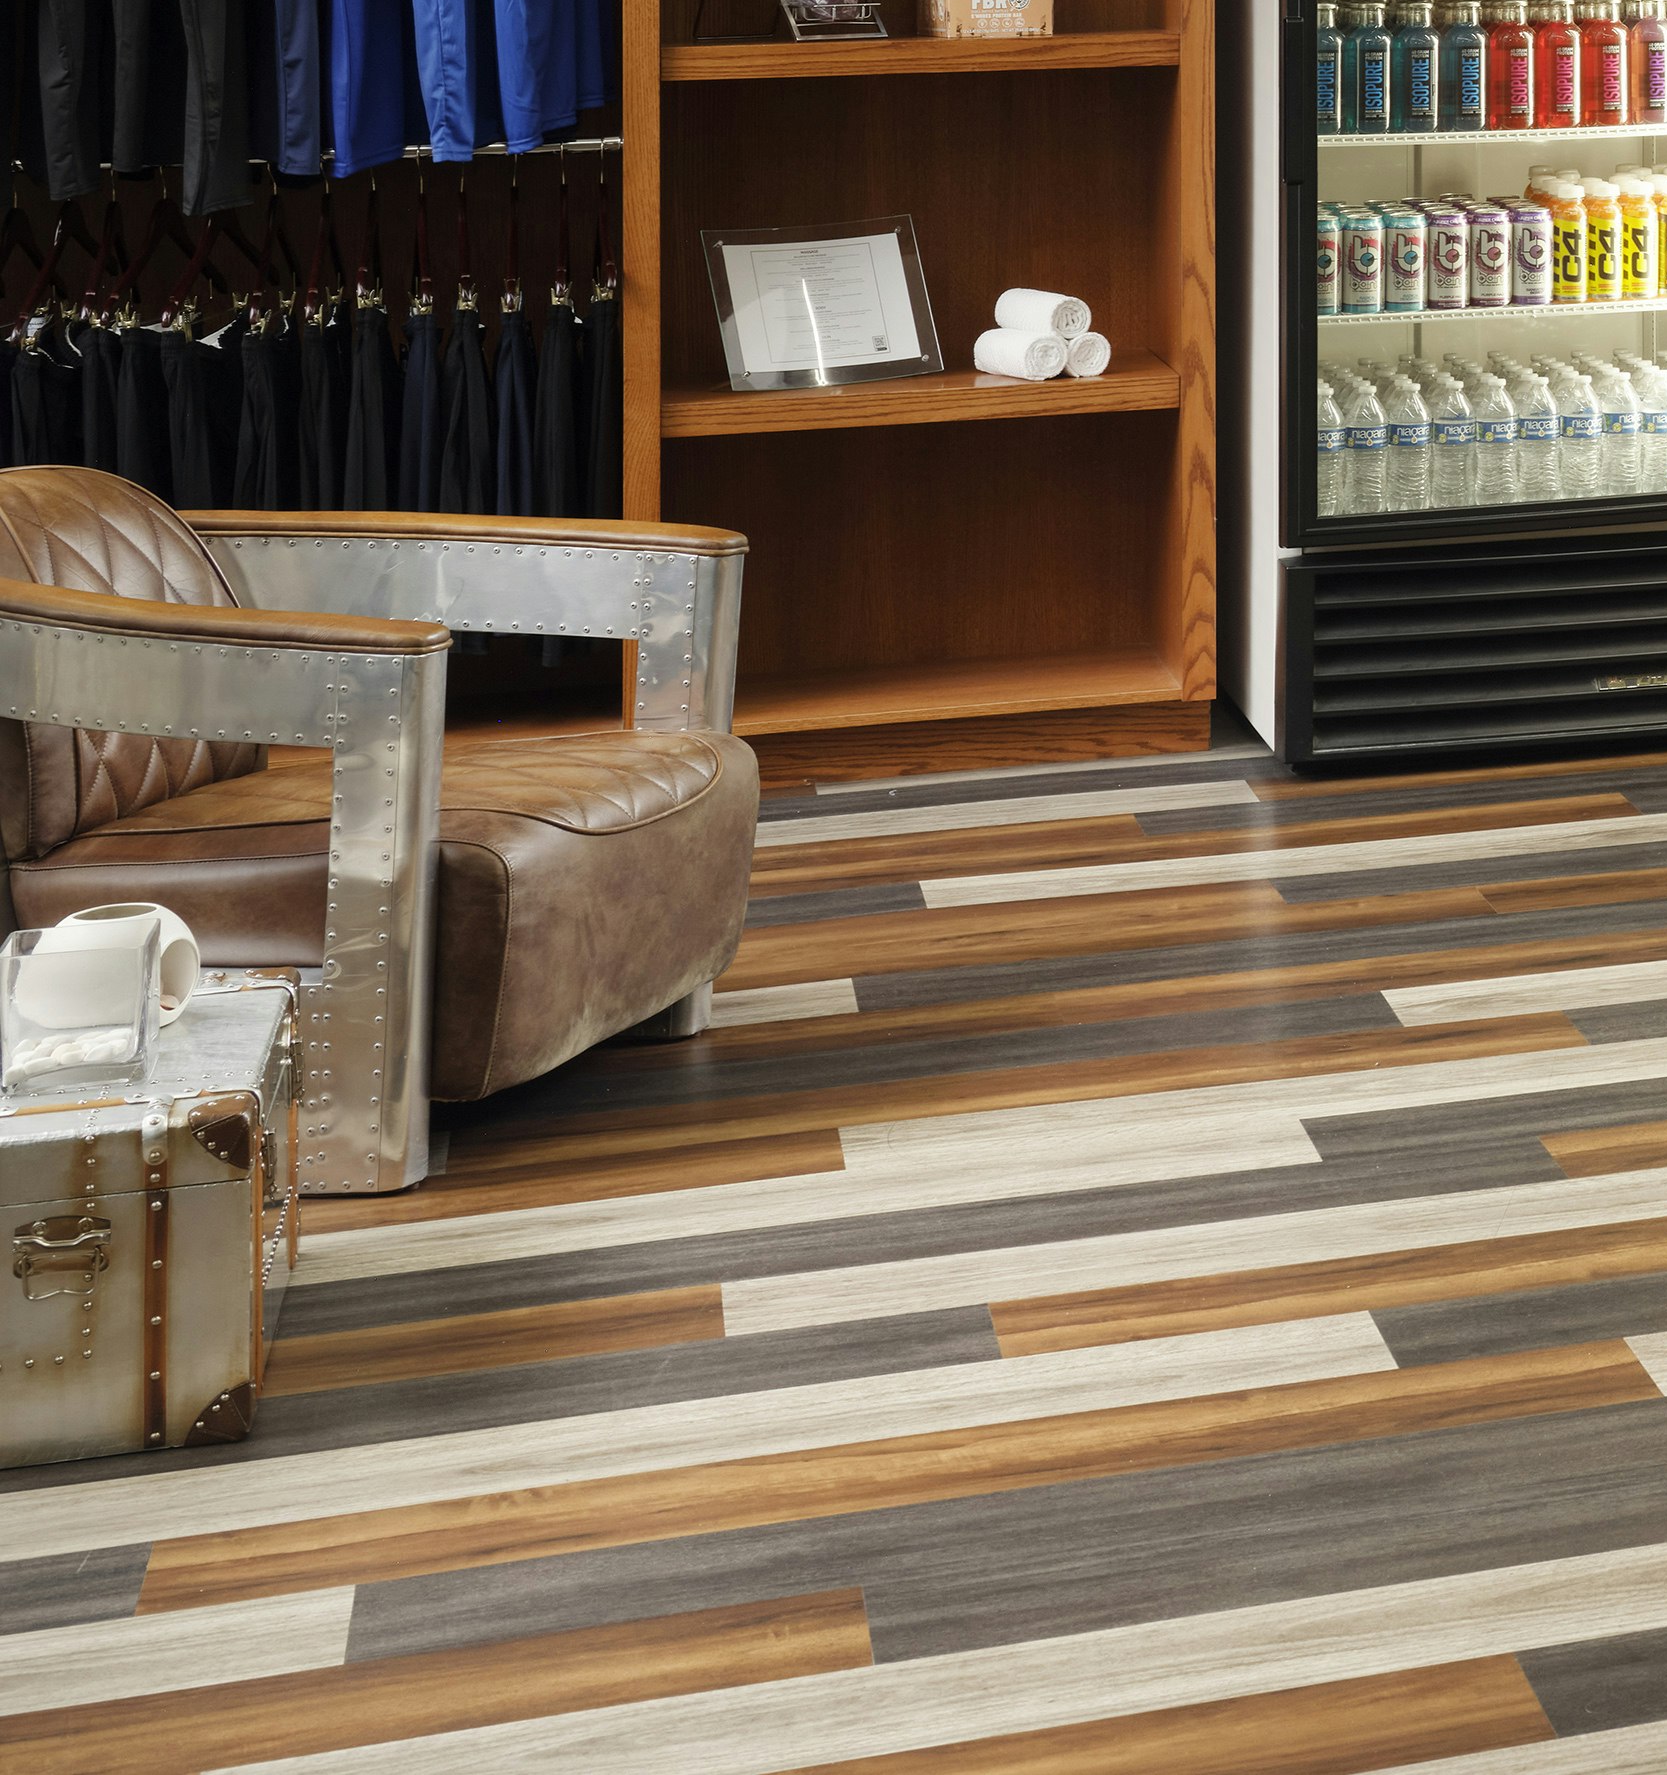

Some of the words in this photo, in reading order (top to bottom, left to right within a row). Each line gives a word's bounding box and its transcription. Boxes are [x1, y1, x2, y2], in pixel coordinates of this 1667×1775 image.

[1365, 60, 1382, 110] ISOPURE
[1412, 59, 1429, 108] ISOPURE
[1462, 57, 1479, 107] ISOPURE
[1510, 57, 1527, 106] ISOPURE
[1556, 56, 1573, 104] ISOPURE
[1604, 54, 1620, 102] ISOPURE
[1650, 51, 1665, 100] ISOPURE
[1562, 229, 1581, 282] C4
[1599, 227, 1616, 280] C4
[1632, 226, 1649, 279] C4
[1352, 428, 1387, 442] niagara
